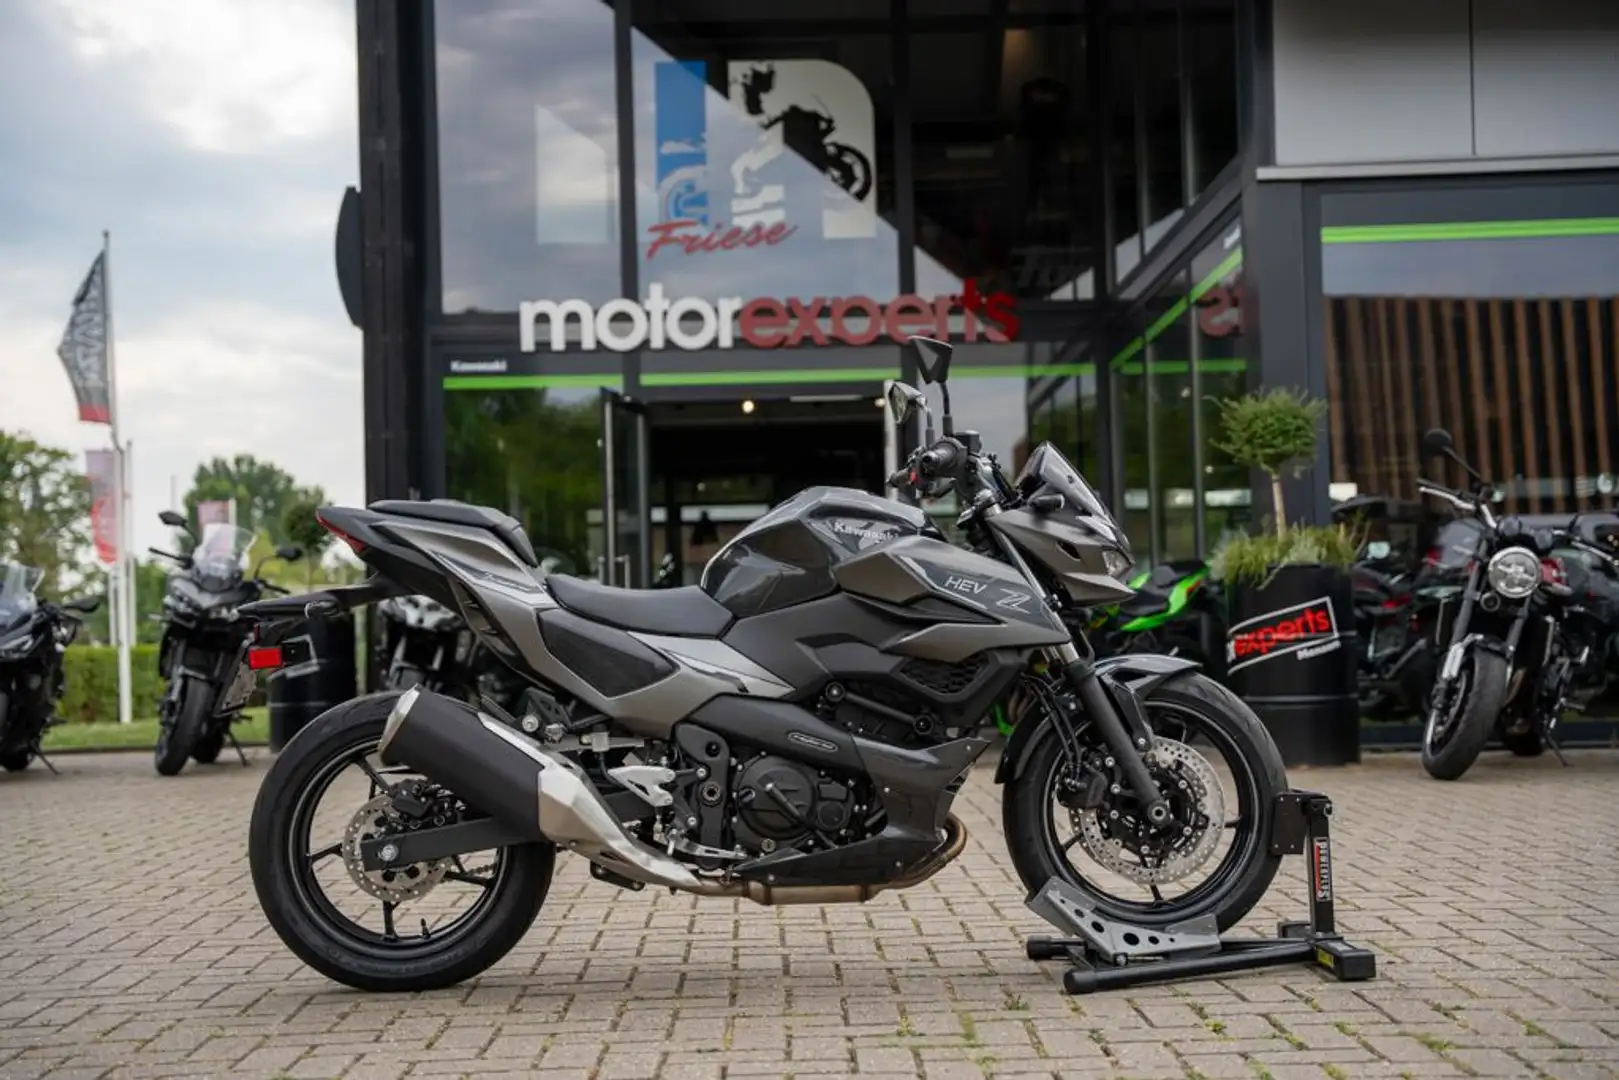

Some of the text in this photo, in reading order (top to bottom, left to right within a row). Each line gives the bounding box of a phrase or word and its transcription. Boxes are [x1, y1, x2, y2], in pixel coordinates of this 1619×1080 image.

[647, 220, 799, 261] Friese
[518, 277, 1019, 352] motorexperts
[944, 575, 988, 595] HEV
